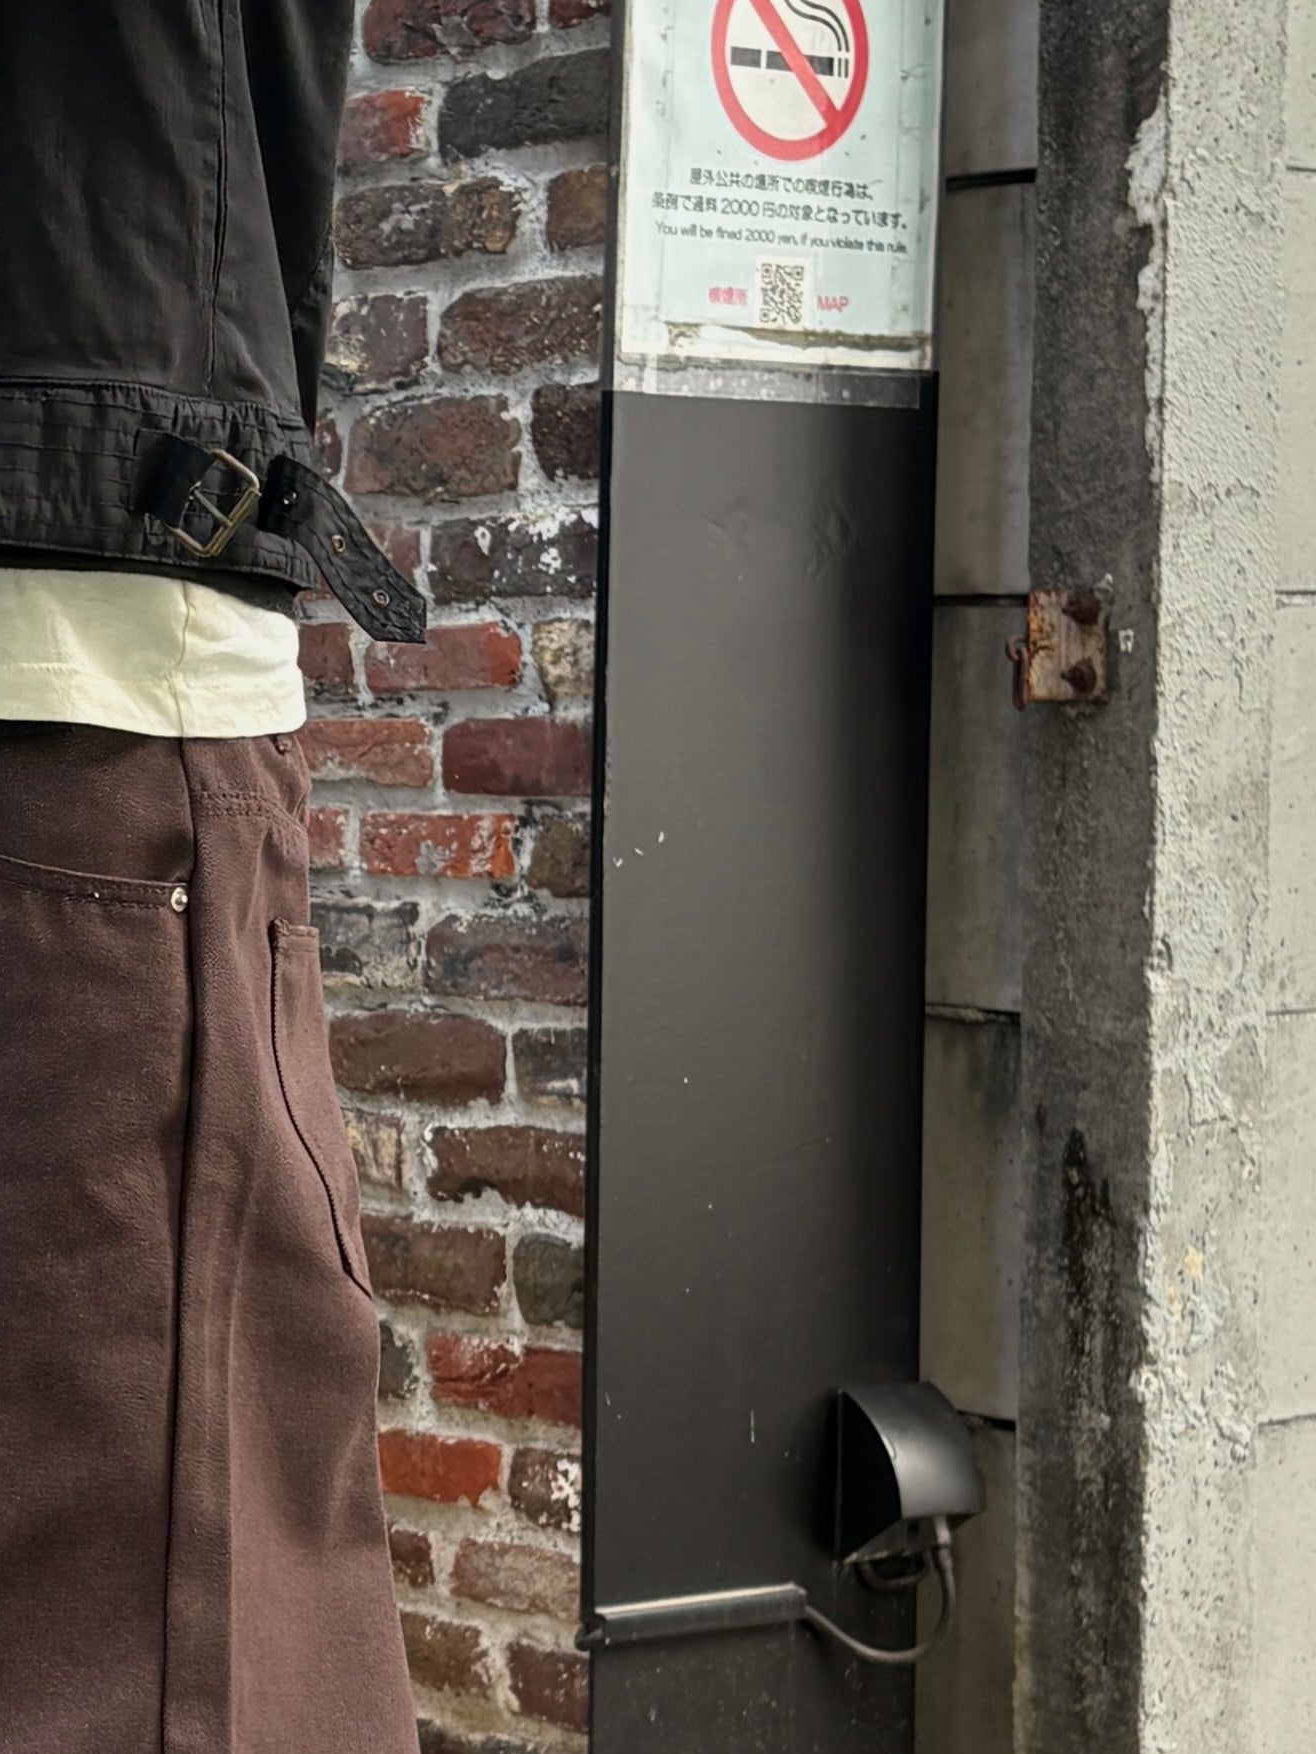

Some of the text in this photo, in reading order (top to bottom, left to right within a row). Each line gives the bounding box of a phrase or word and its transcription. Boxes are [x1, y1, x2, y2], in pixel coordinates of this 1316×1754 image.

[655, 220, 678, 236] You
[680, 223, 697, 237] will
[699, 224, 713, 238] be
[716, 225, 742, 241] fined
[744, 228, 776, 243] 2000
[817, 294, 849, 312] MAP
